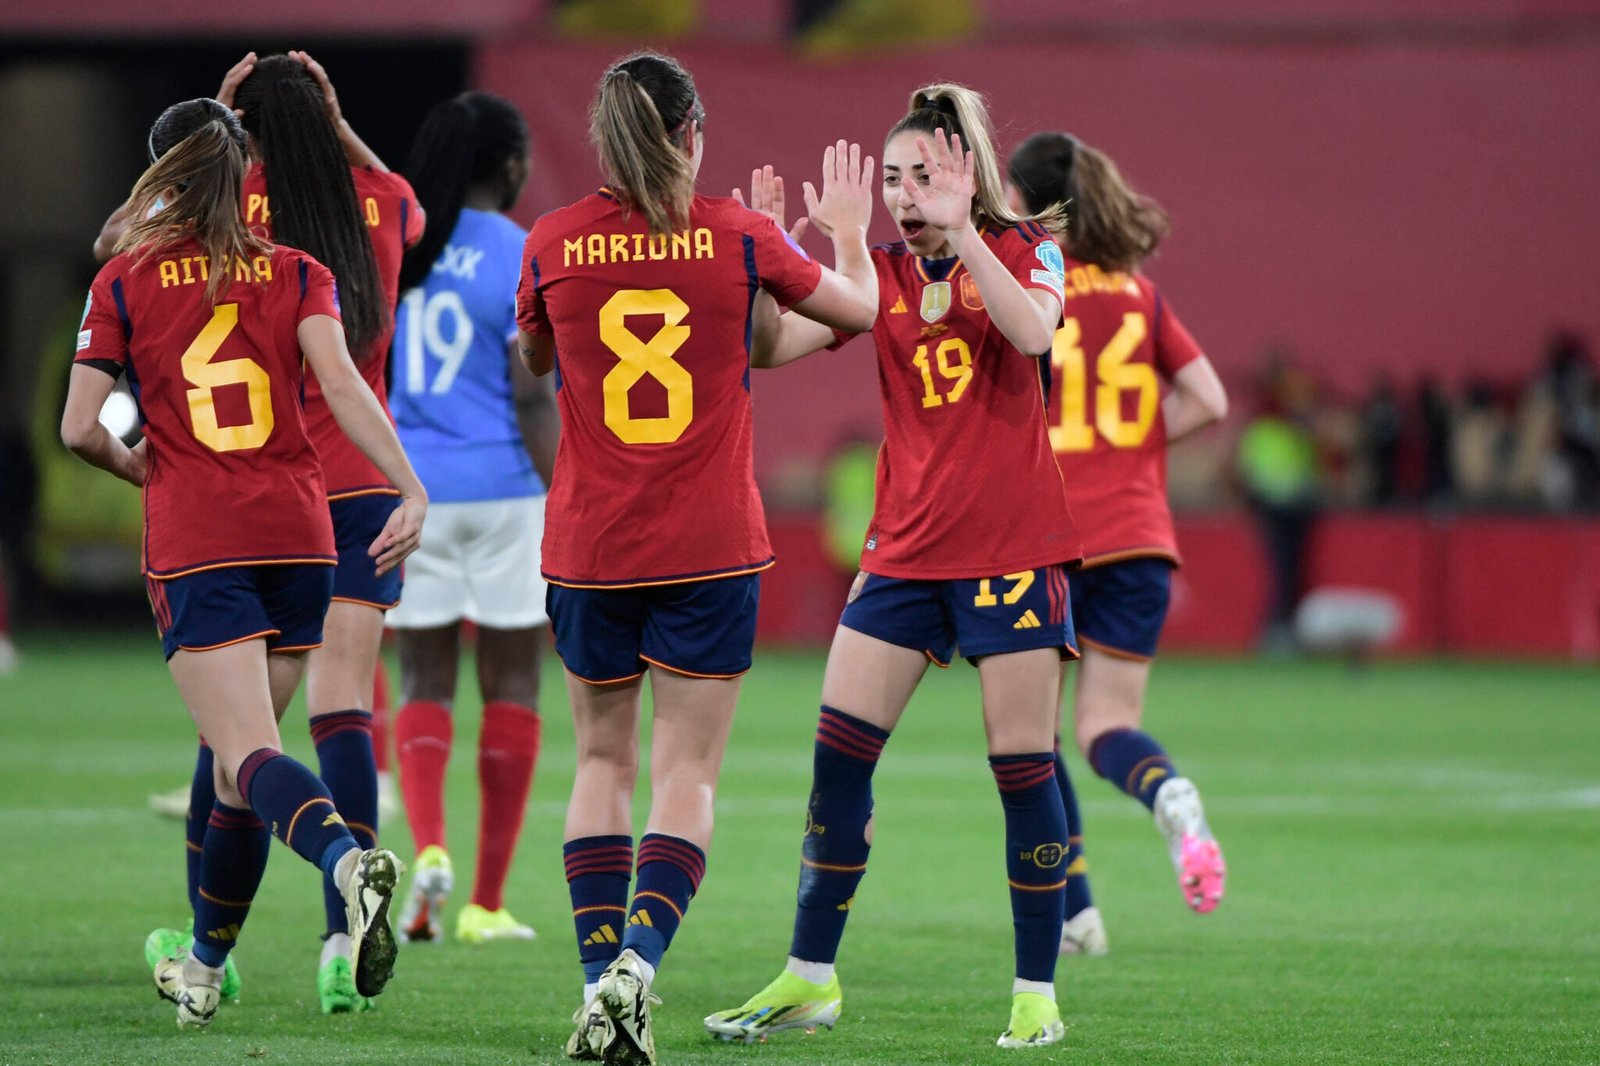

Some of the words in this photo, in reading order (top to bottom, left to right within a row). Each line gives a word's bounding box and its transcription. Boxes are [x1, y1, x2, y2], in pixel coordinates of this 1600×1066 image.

[564, 228, 714, 267] MARIONA
[180, 302, 275, 452] 6
[404, 287, 474, 395] 19
[599, 288, 694, 444] 8
[912, 337, 974, 409] 19
[1048, 312, 1158, 452] 16
